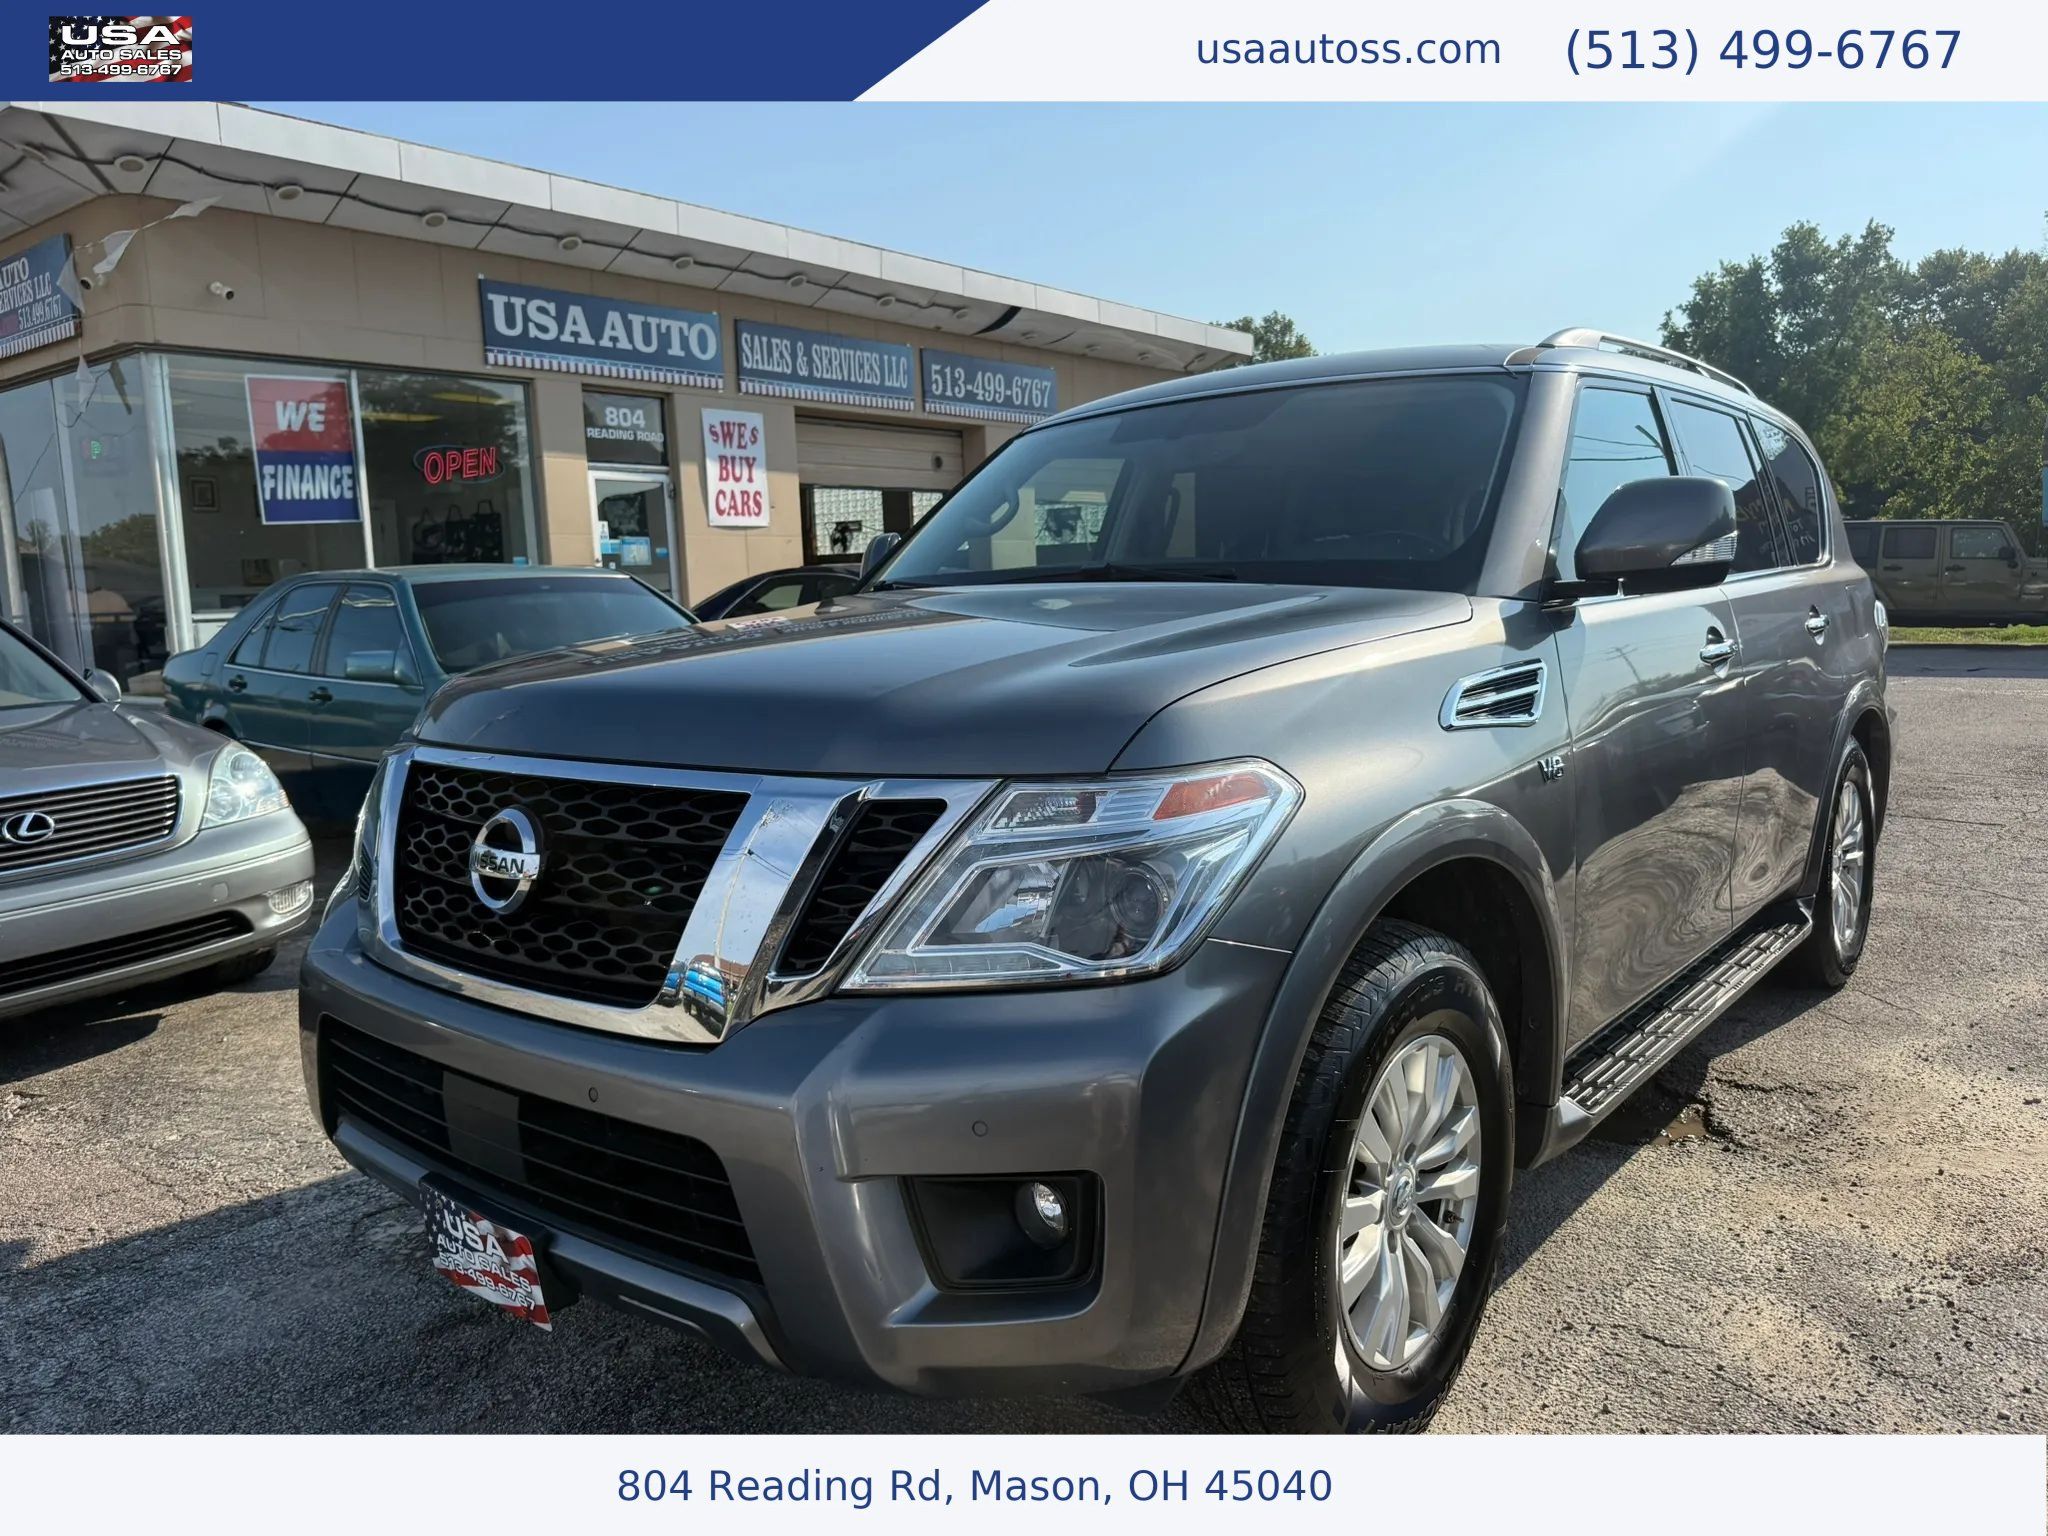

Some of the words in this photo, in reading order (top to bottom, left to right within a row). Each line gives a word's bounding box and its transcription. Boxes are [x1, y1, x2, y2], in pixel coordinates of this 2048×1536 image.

[487, 293, 595, 346] USA
[599, 310, 718, 361] AUTO
[741, 332, 793, 375] SALES
[796, 341, 809, 377] &
[812, 344, 881, 386] SERVICES
[884, 354, 908, 389] LLC
[931, 363, 1052, 409] 513-499-6767
[275, 400, 326, 433] WE
[587, 427, 634, 441] READING
[637, 430, 664, 444] ROAD
[605, 407, 646, 428] 804
[262, 464, 353, 501] FINANCE
[423, 447, 496, 485] OPEN
[718, 455, 757, 483] BUY
[715, 488, 762, 517] CARS
[444, 1208, 510, 1264] USA
[437, 1233, 476, 1264] AUTO
[478, 1256, 532, 1293] SALES
[439, 1251, 535, 1311] 513-499-6767
